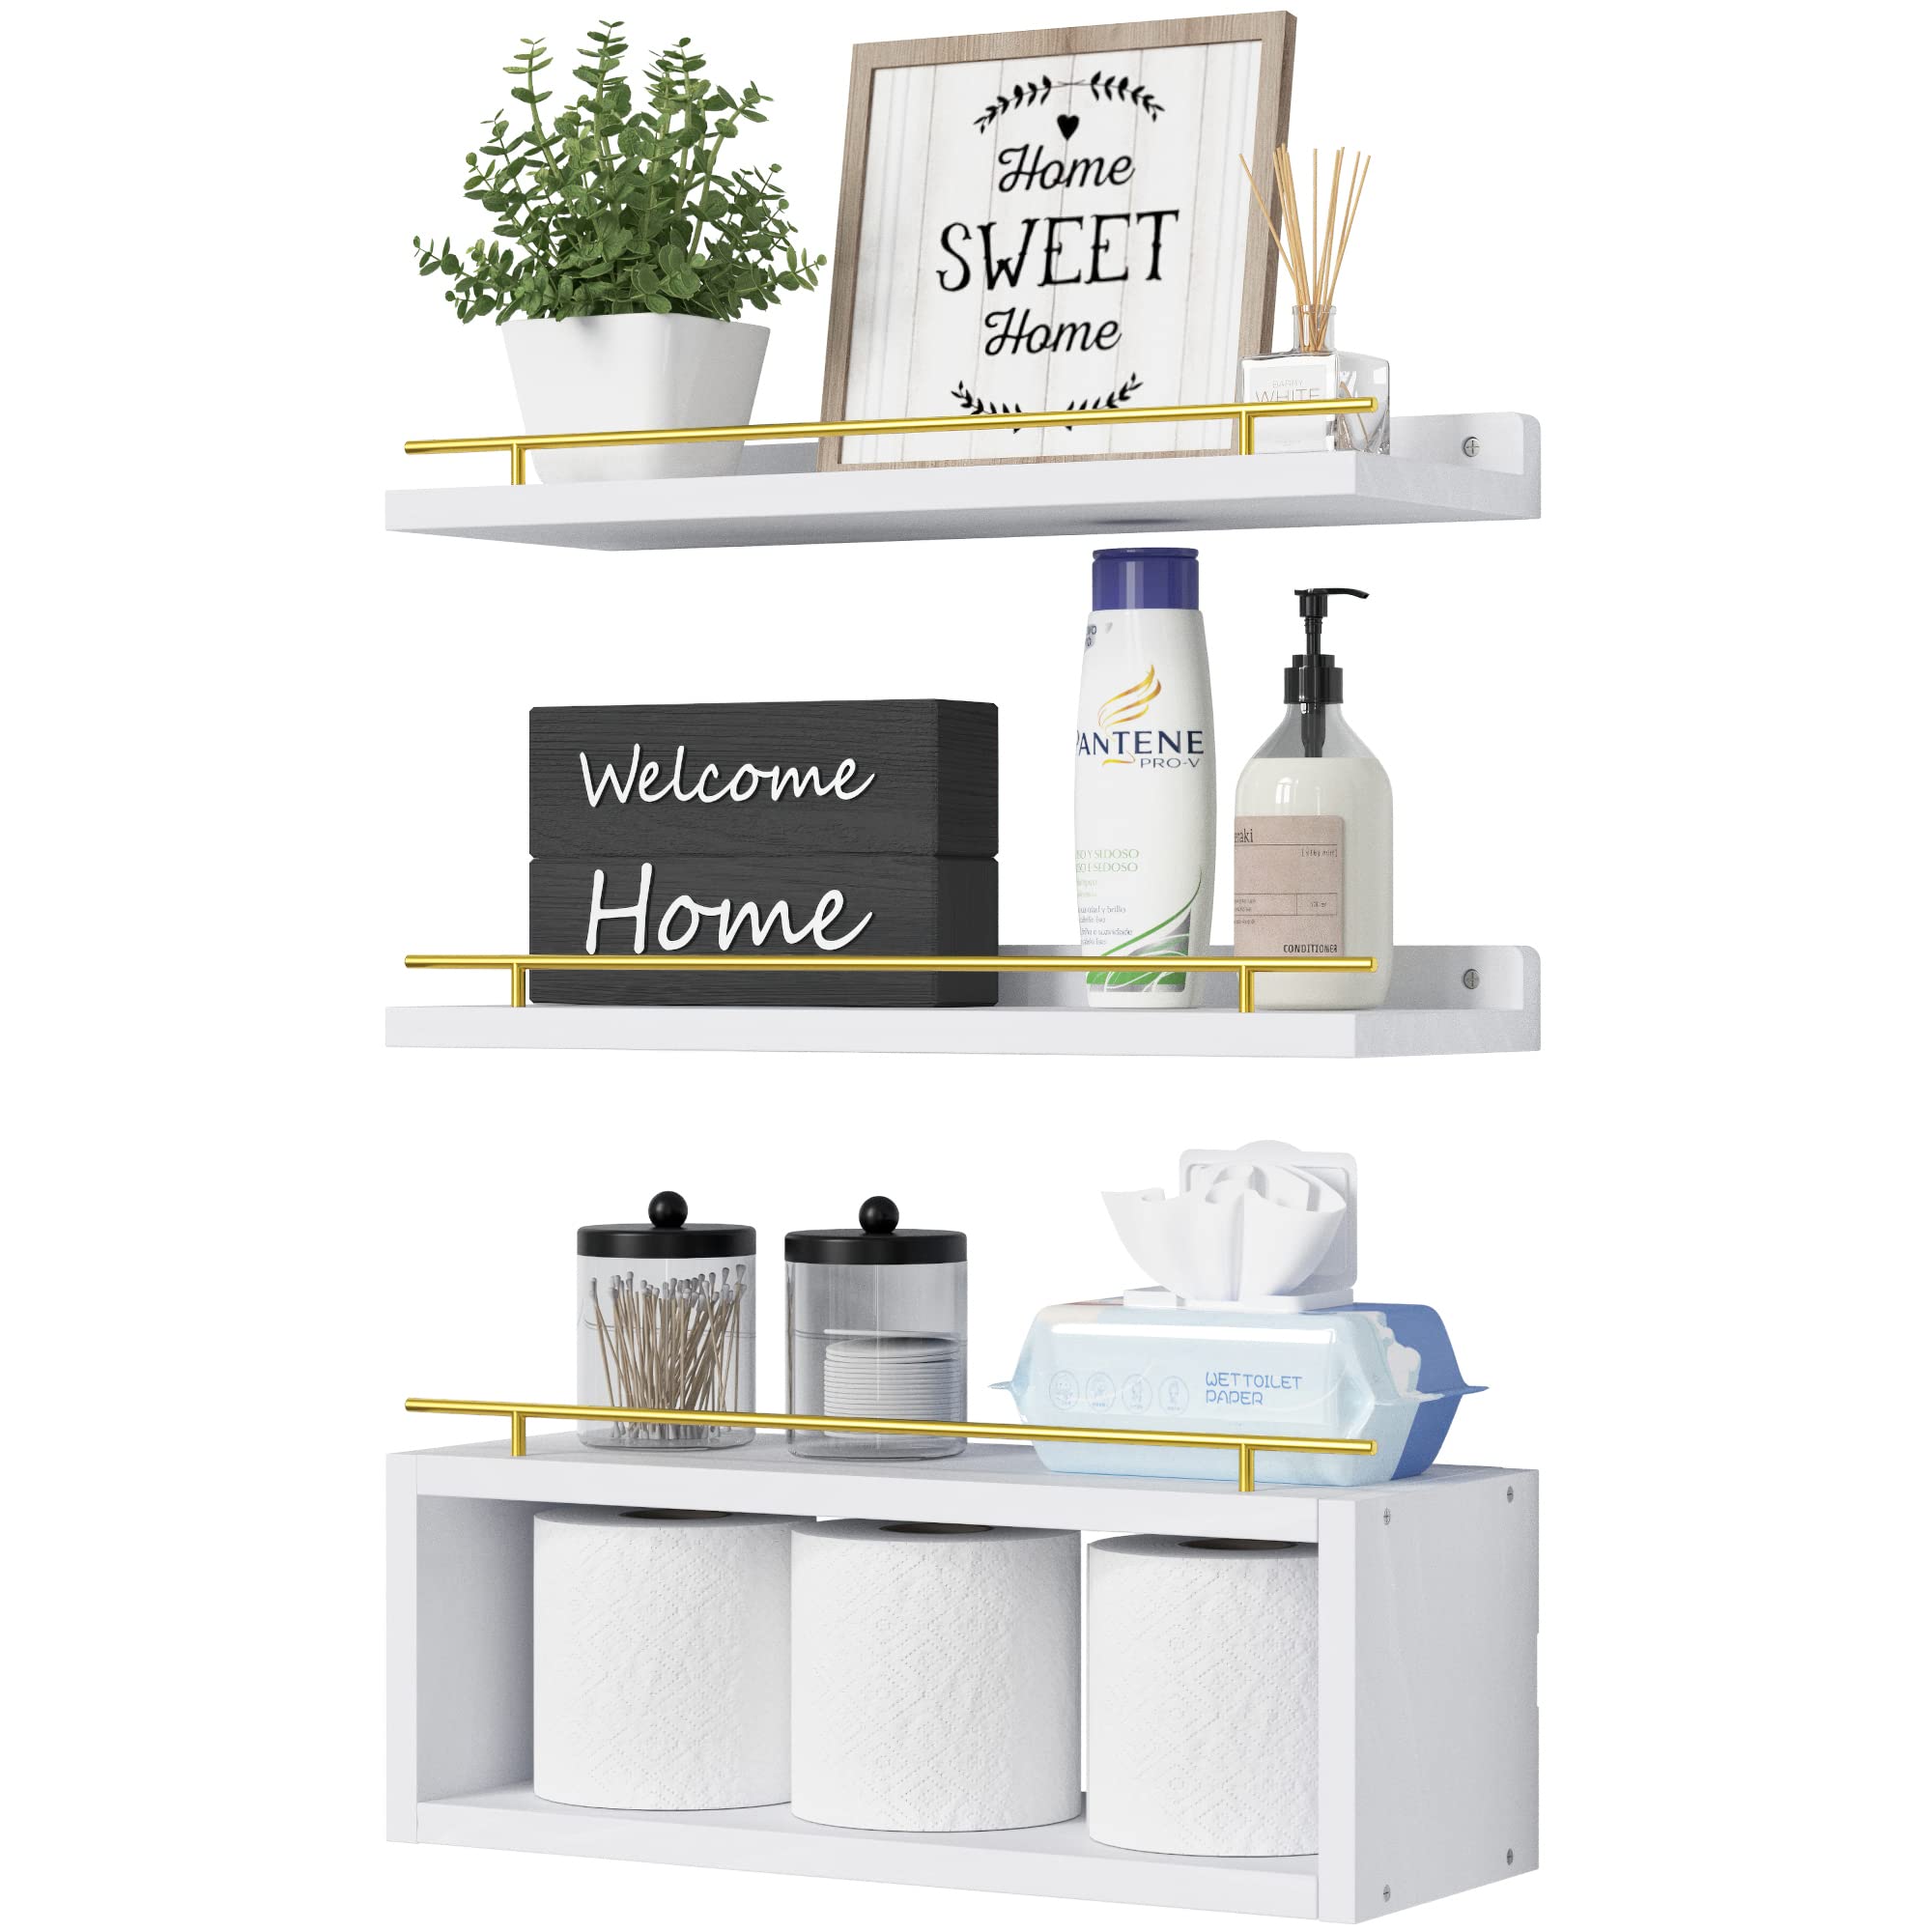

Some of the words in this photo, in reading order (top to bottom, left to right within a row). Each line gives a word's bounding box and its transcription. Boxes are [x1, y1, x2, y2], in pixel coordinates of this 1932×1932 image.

[998, 144, 1136, 192] Home
[936, 210, 1179, 292] SWEET
[984, 307, 1122, 356] Home
[580, 743, 875, 808] Welcome
[1140, 757, 1201, 769] PRO-V
[585, 862, 873, 954] Home
[1283, 944, 1338, 953] CONDITIONER
[1205, 1371, 1240, 1387] WET
[1242, 1373, 1303, 1389] TOILET
[1205, 1389, 1264, 1406] PAPER
